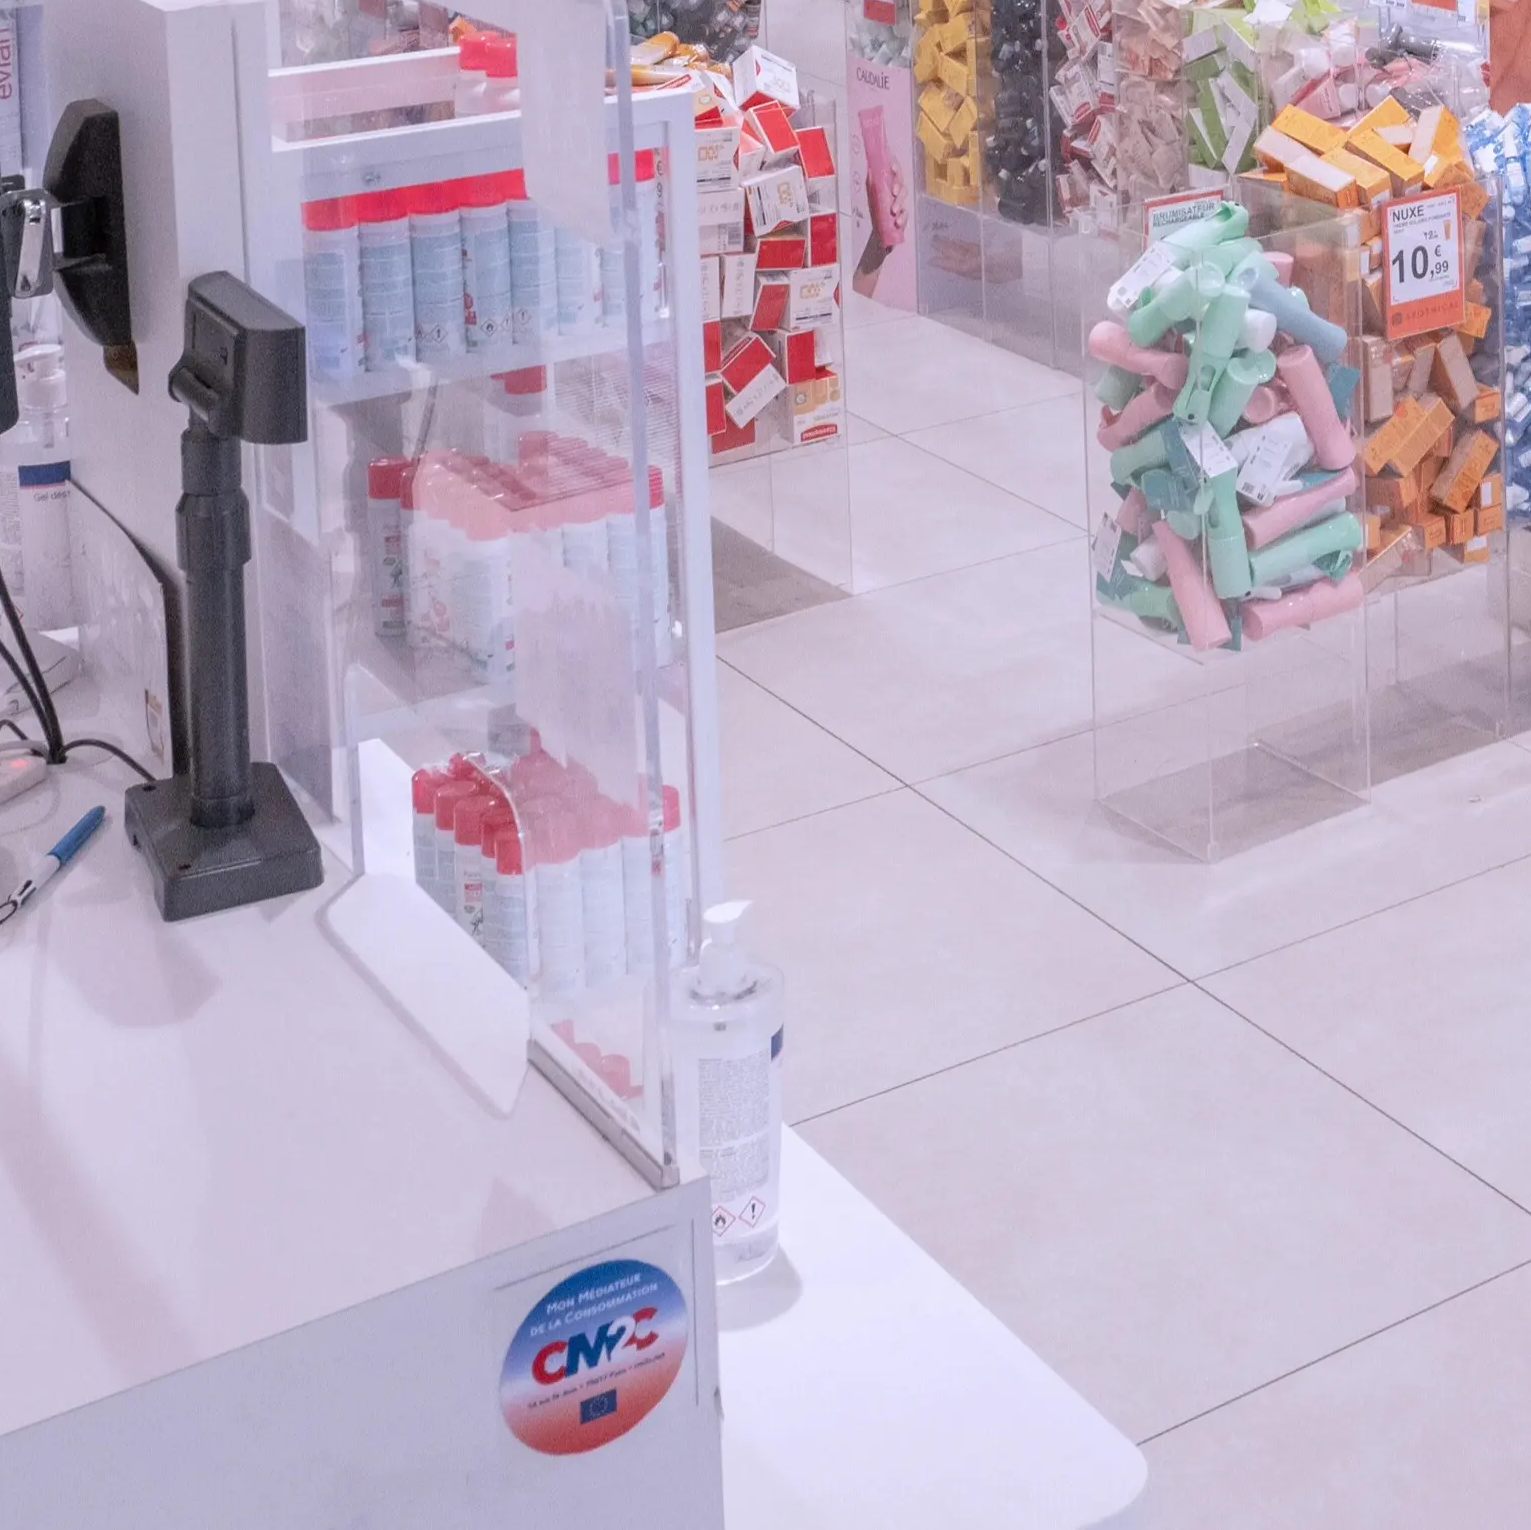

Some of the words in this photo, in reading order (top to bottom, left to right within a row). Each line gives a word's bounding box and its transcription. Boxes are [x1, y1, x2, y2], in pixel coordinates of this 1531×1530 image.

[1152, 201, 1218, 223] BRUMISATEUR
[1392, 205, 1424, 222] NUXE
[531, 1306, 659, 1385] CM2C
